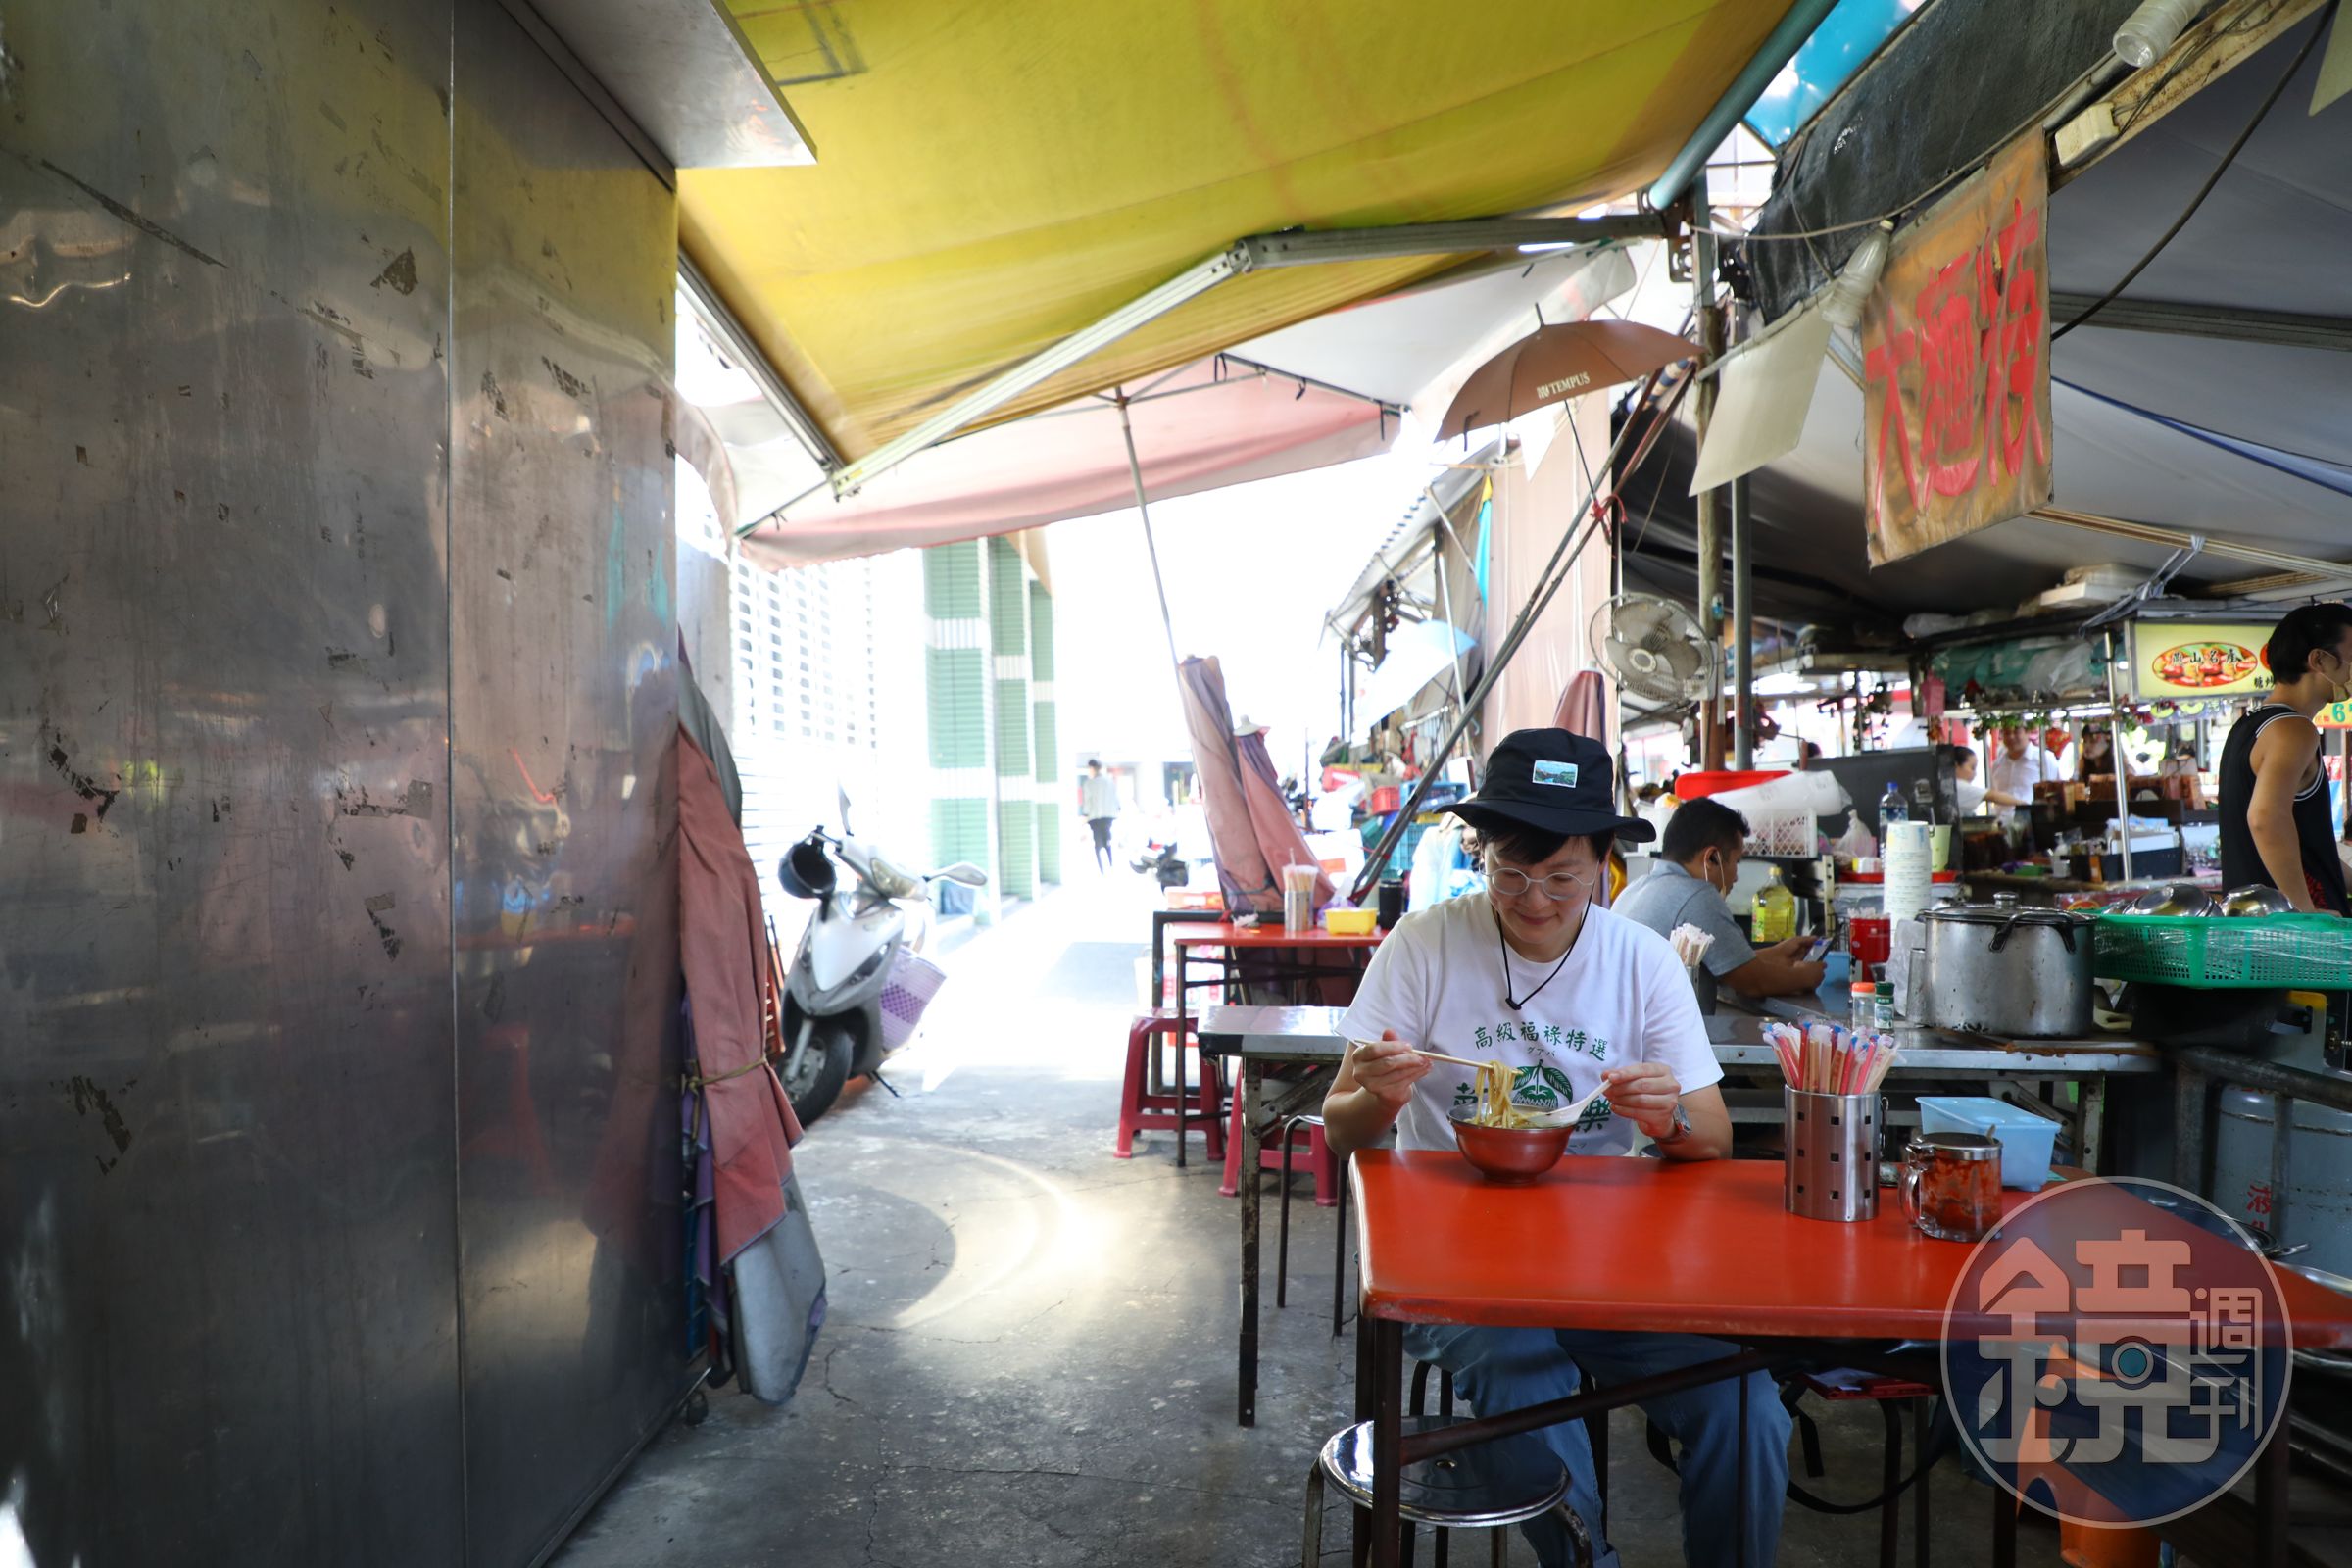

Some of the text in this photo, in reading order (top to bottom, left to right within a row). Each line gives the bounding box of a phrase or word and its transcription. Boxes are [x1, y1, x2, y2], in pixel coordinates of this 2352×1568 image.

[1548, 370, 1590, 394] TEMPUS
[1474, 1021, 1607, 1062] 高級福祿特選
